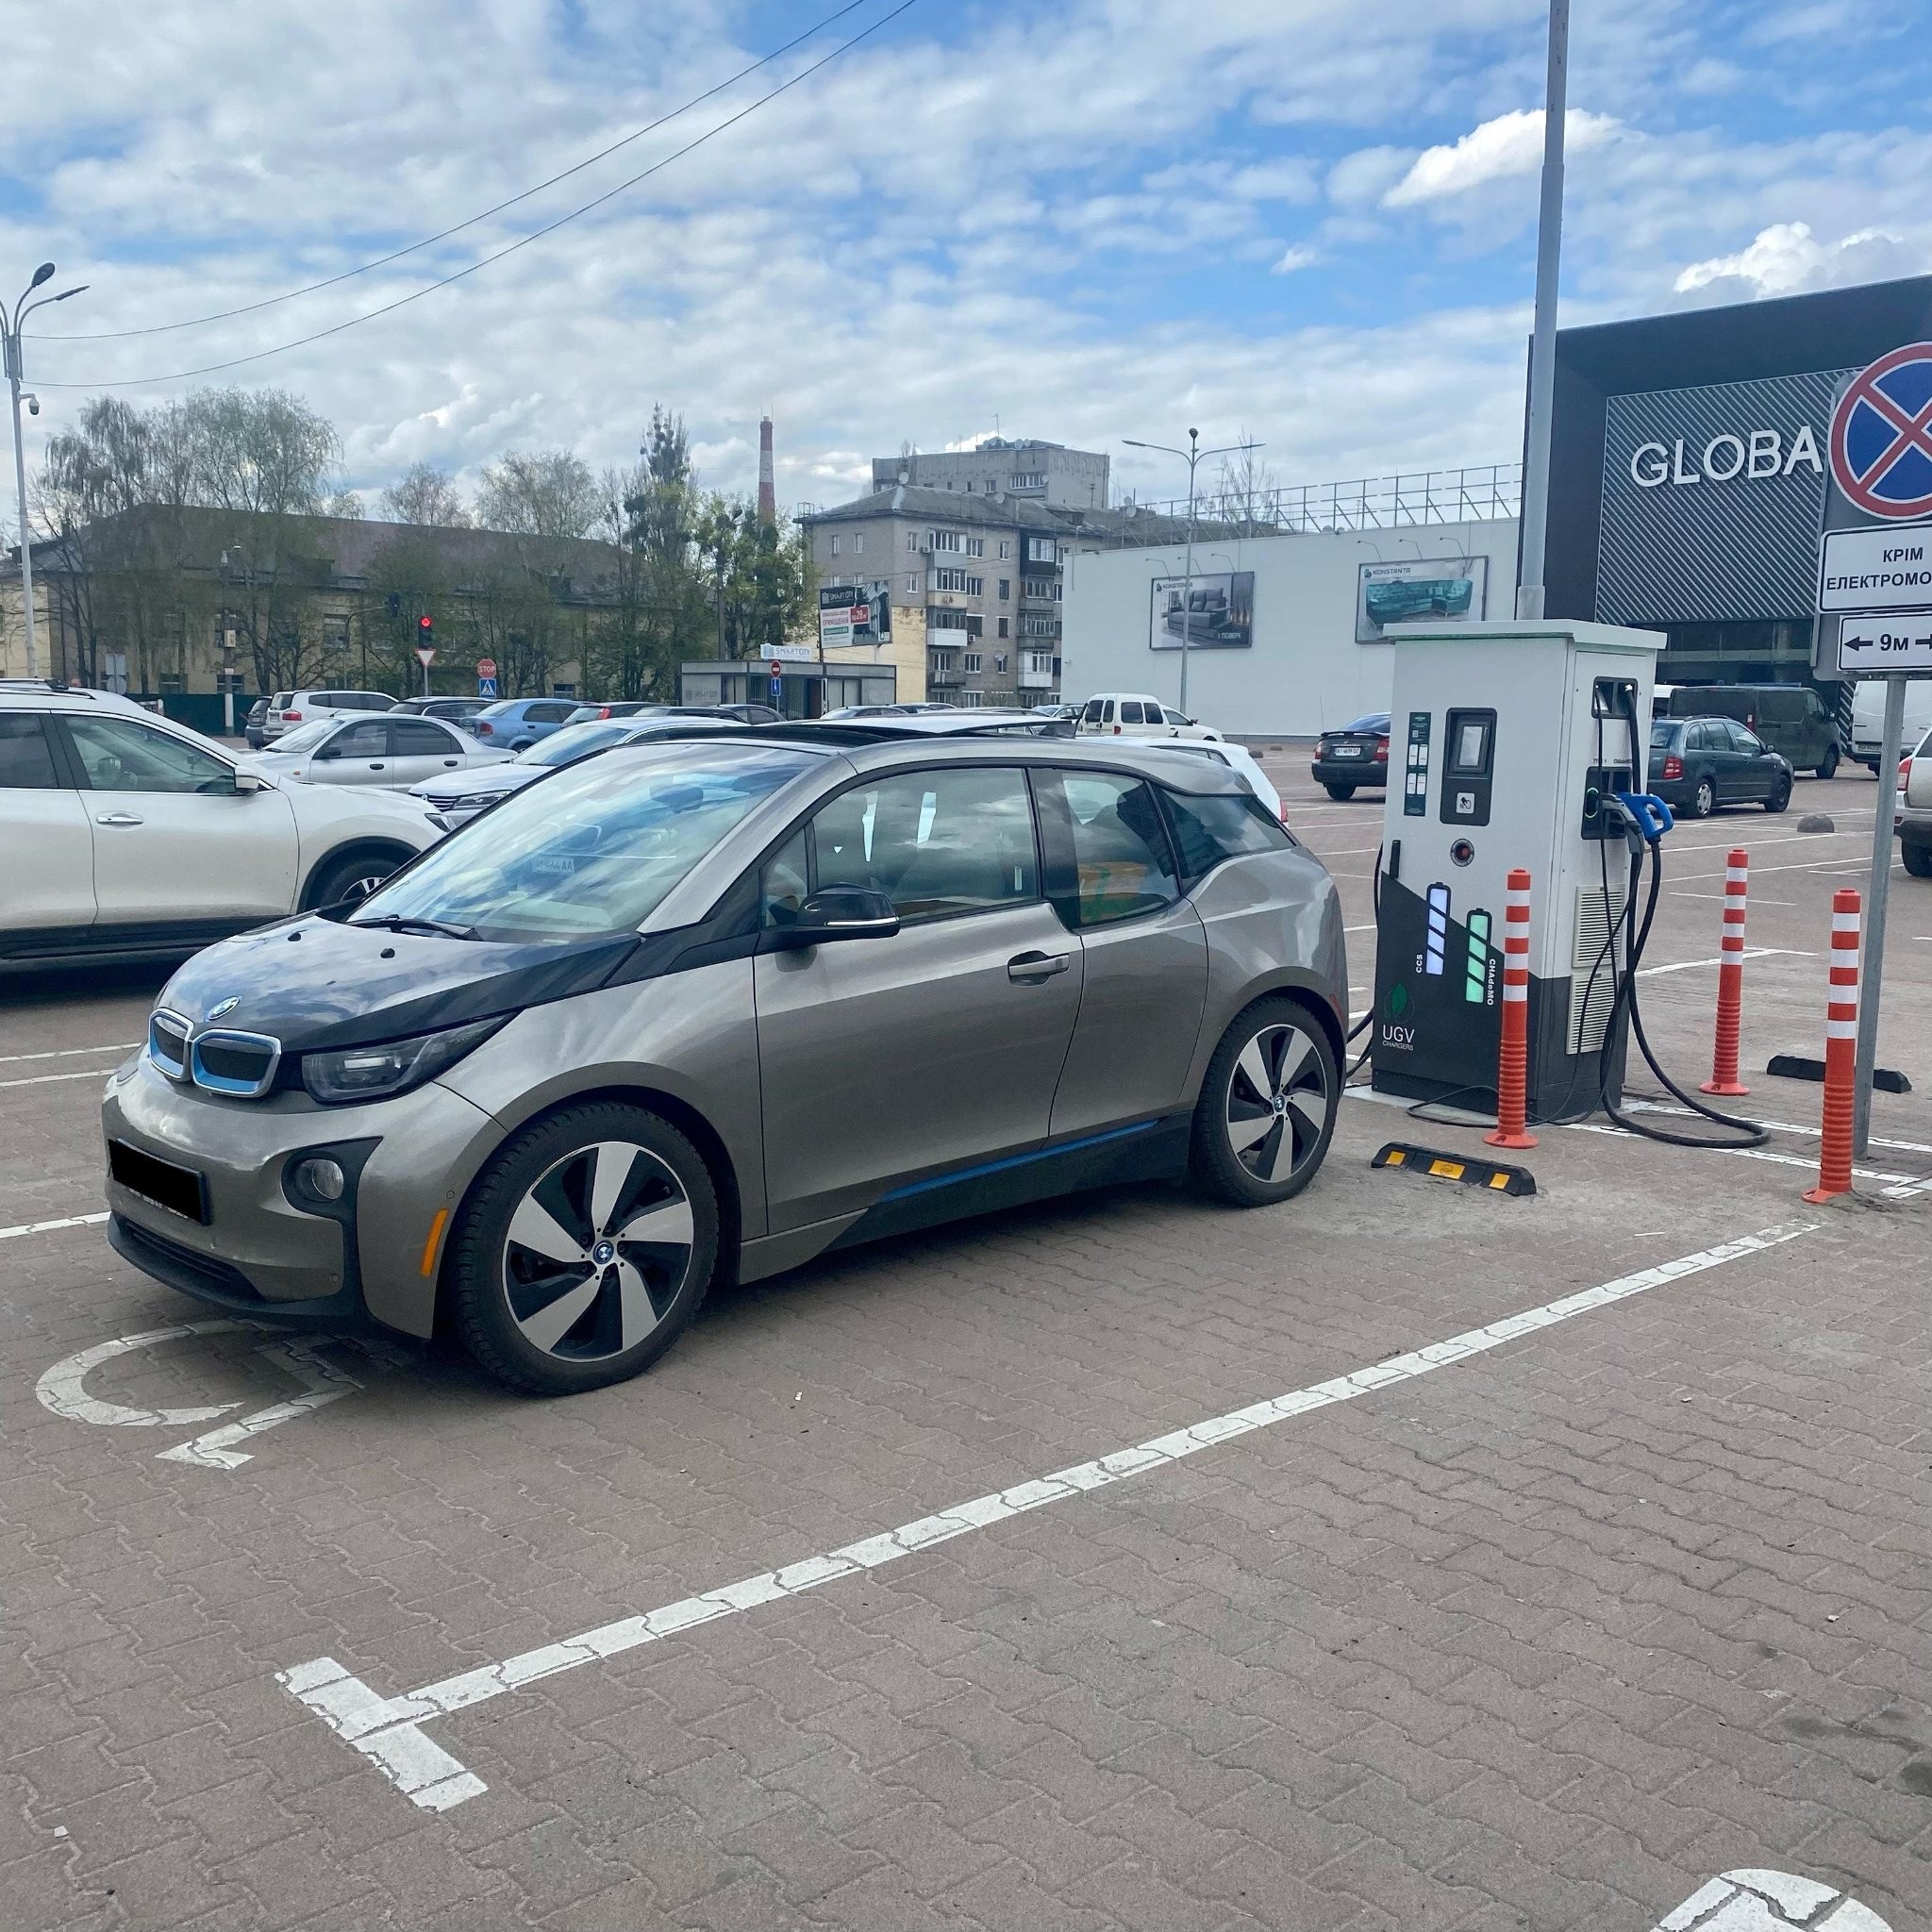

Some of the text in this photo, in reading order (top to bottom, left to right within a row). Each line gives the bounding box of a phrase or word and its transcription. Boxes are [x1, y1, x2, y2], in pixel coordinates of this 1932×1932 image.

[1630, 425, 1824, 488] GLOBA
[1882, 547, 1924, 563] КРІМ
[1826, 571, 1932, 591] ЕЛЕКТРОМО
[1879, 633, 1909, 652] 9м
[1415, 954, 1424, 974] CCS
[1382, 1024, 1415, 1043] UGV
[1382, 1041, 1414, 1051] CHARGERS
